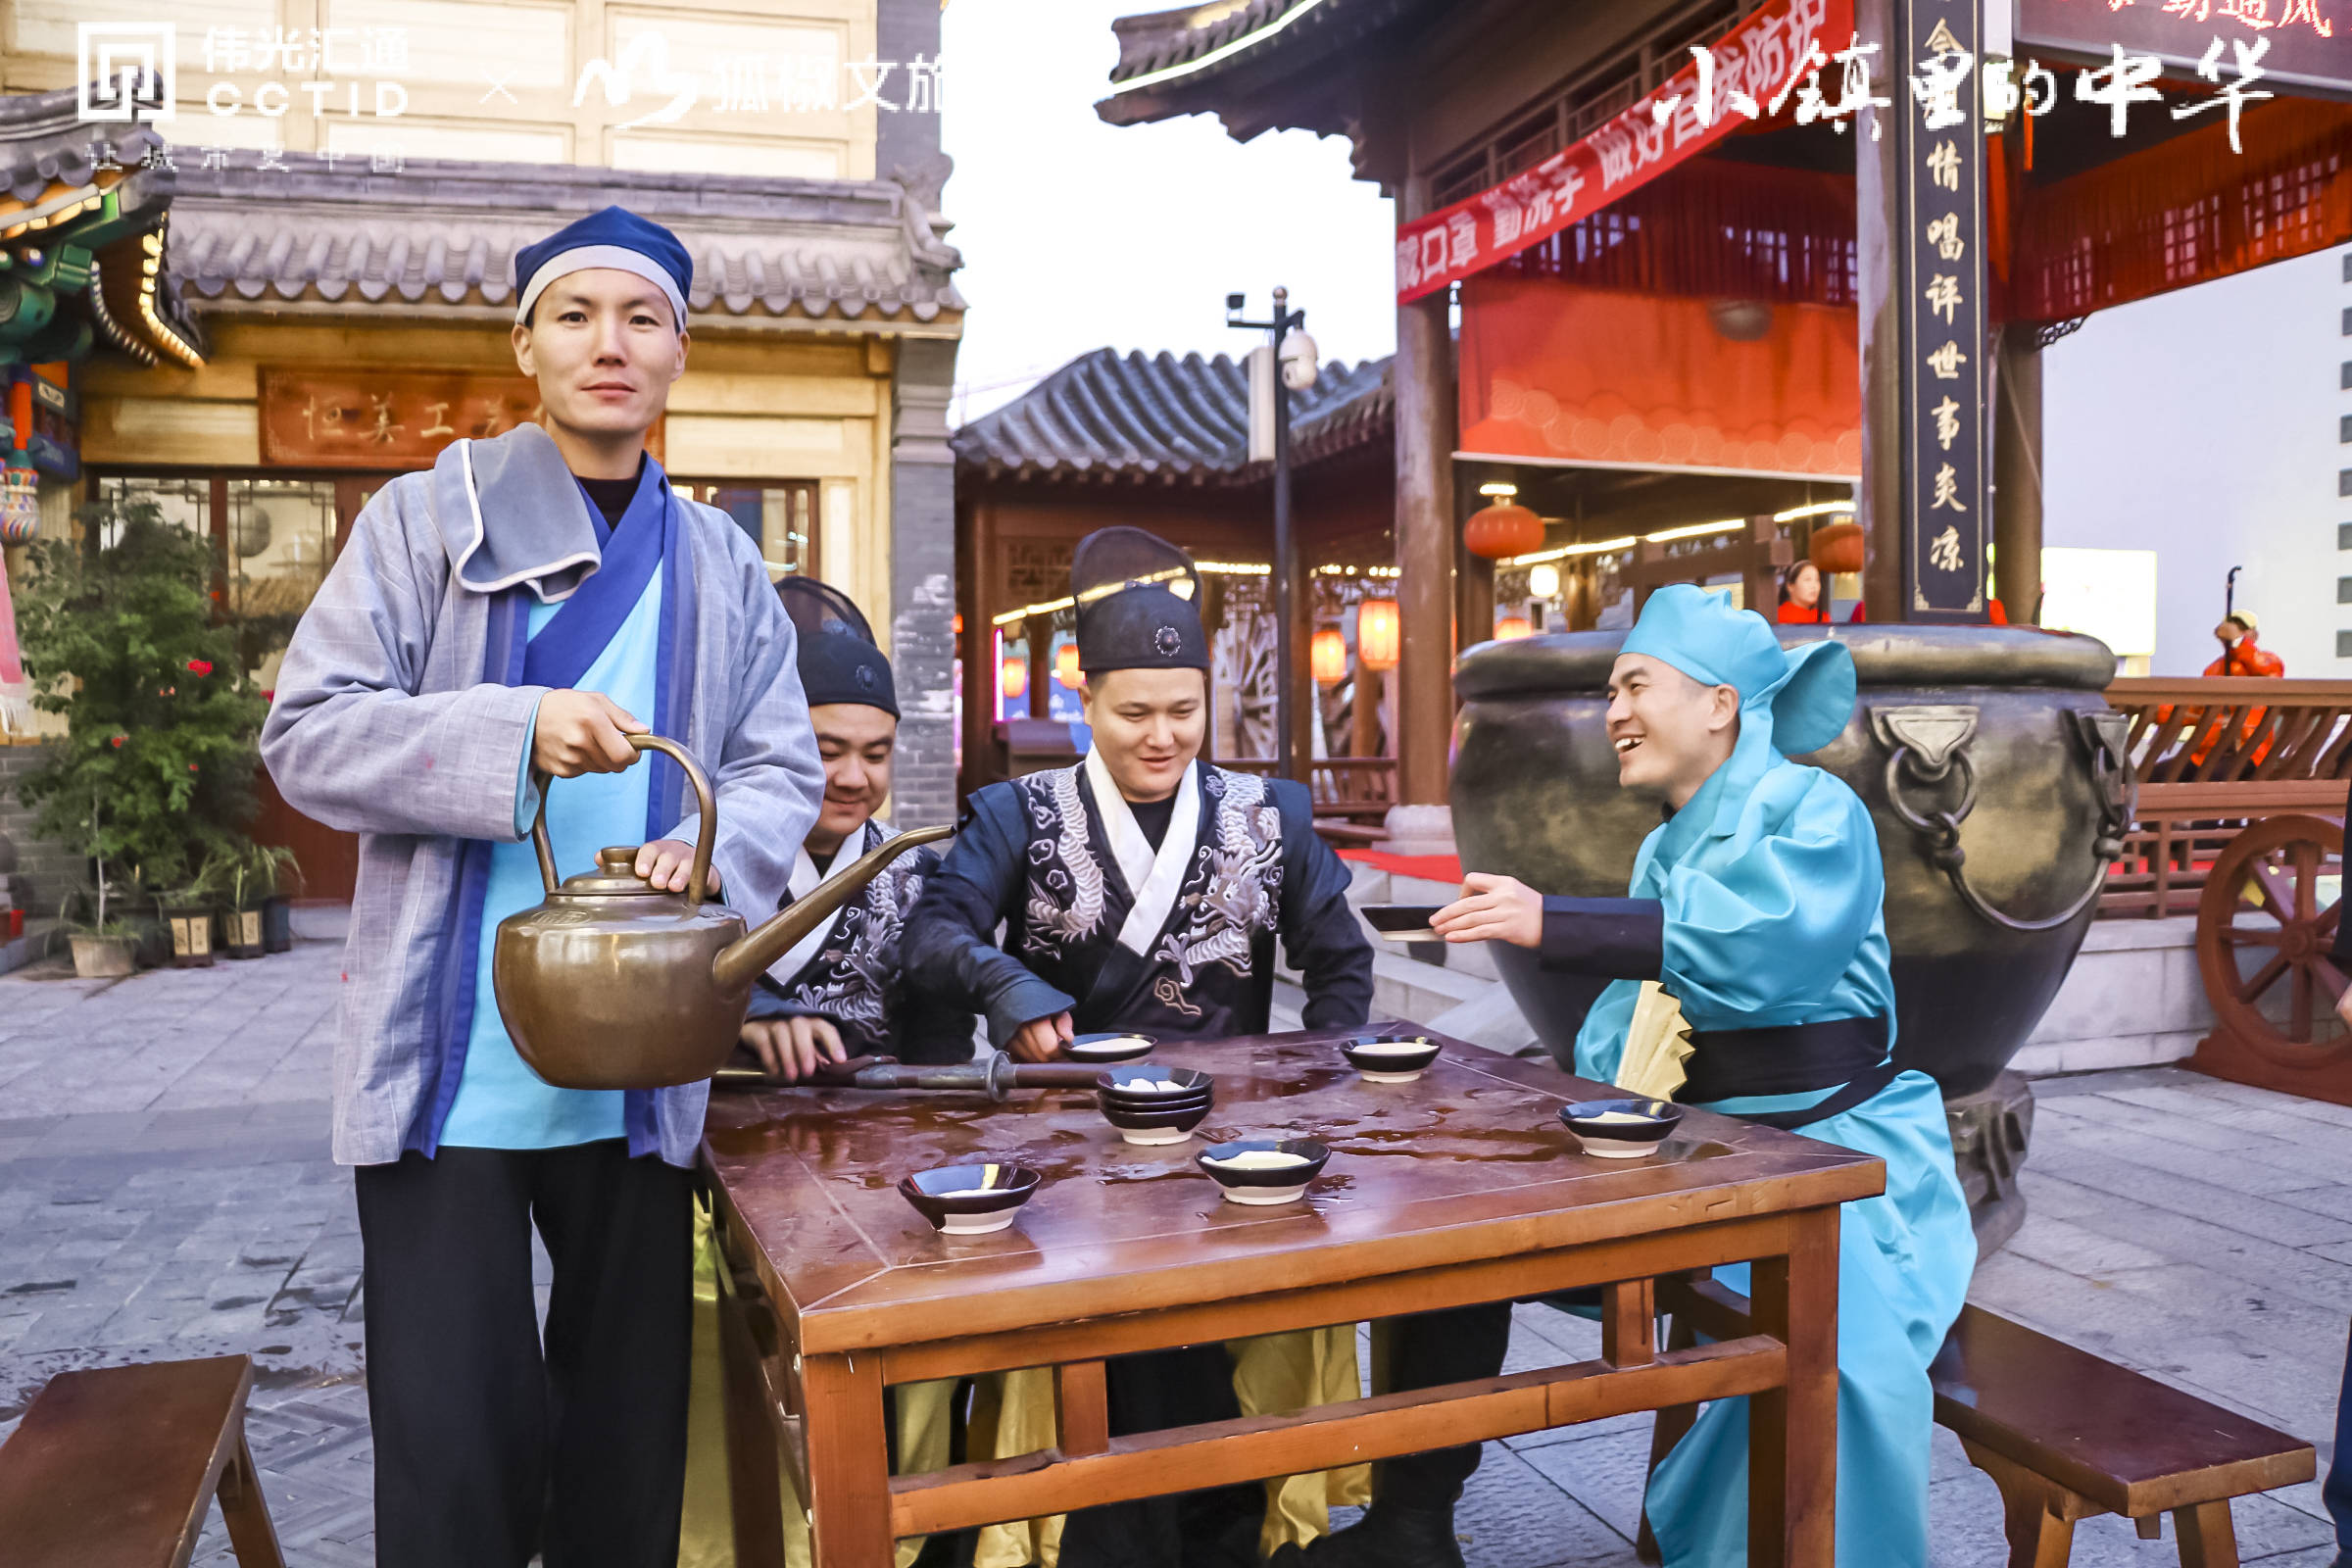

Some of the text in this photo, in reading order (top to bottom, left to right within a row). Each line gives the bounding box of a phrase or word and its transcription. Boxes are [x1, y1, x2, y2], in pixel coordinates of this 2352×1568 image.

[1397, 209, 1479, 290] 戴口罩
[1482, 154, 1585, 249] 勤洗手
[1924, 17, 1968, 572] 今情唱评世事炎凉
